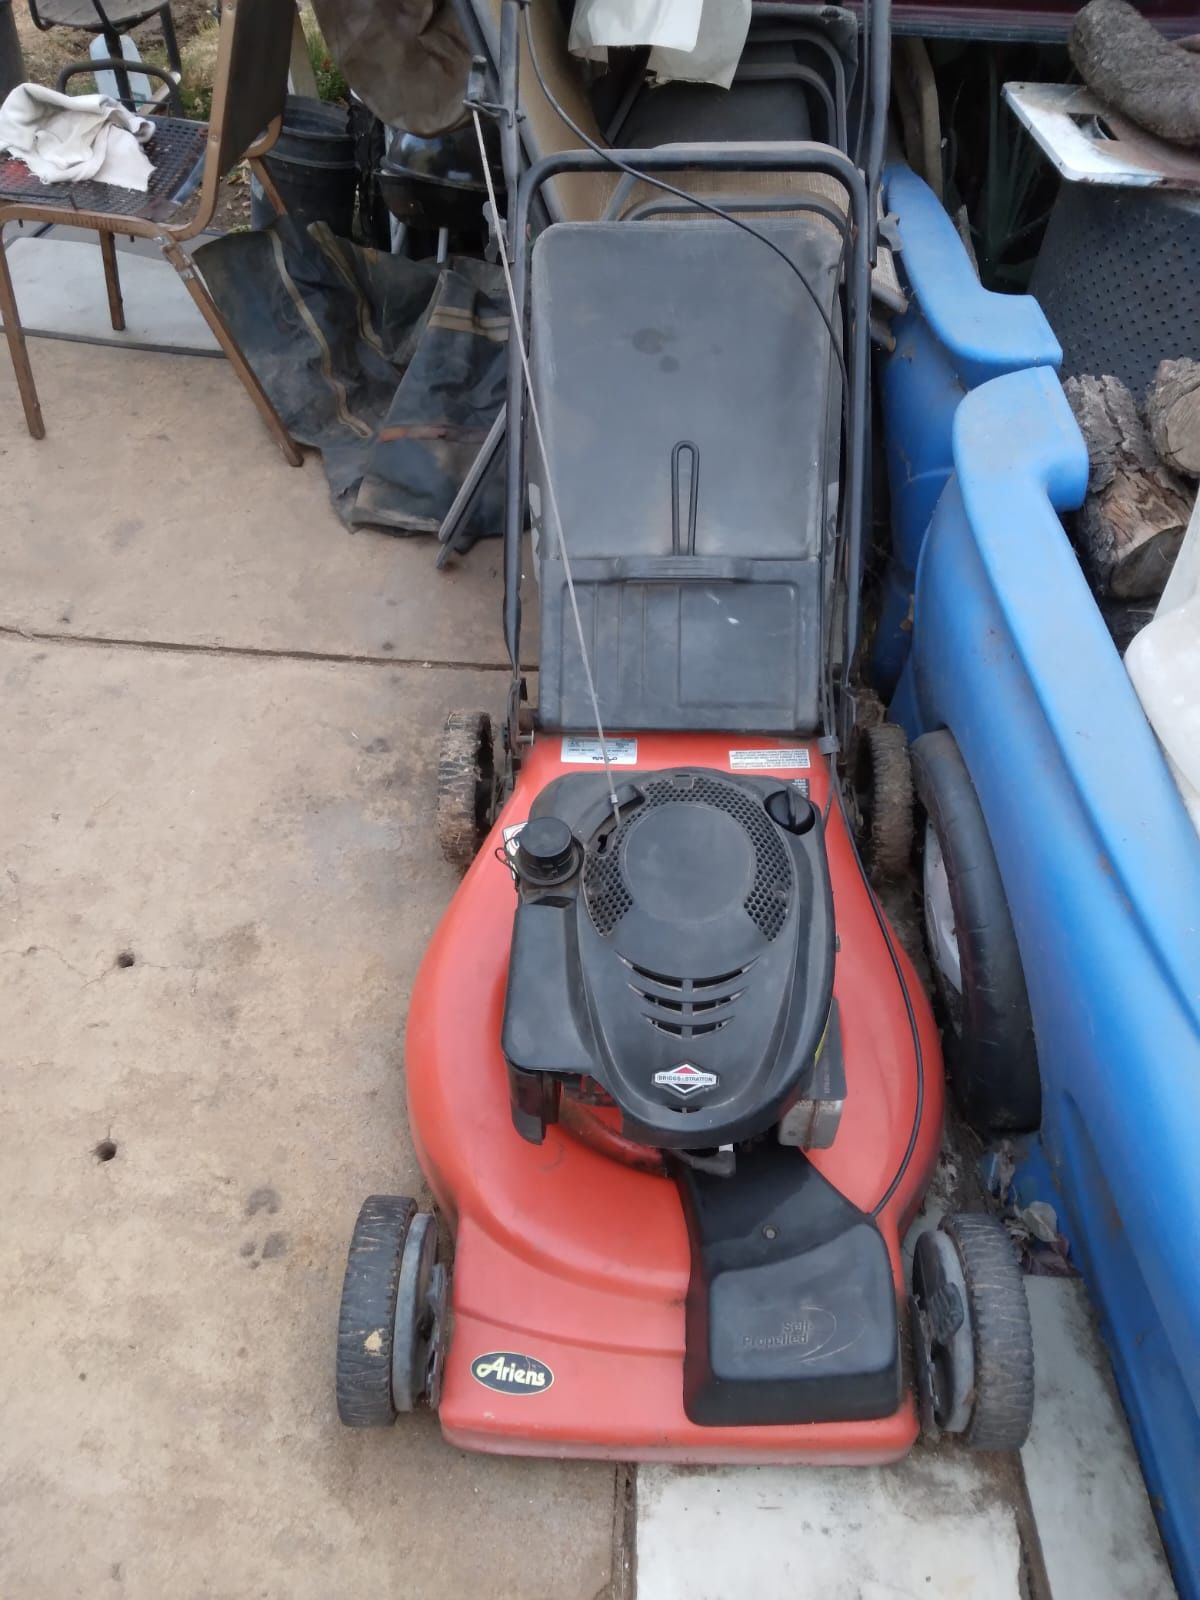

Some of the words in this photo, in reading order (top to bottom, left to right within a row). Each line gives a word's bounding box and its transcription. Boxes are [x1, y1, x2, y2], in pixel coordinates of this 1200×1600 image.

[657, 1074, 681, 1082] BRIGGS
[743, 1333, 809, 1348] Propelled
[476, 1356, 546, 1387] Ariens
